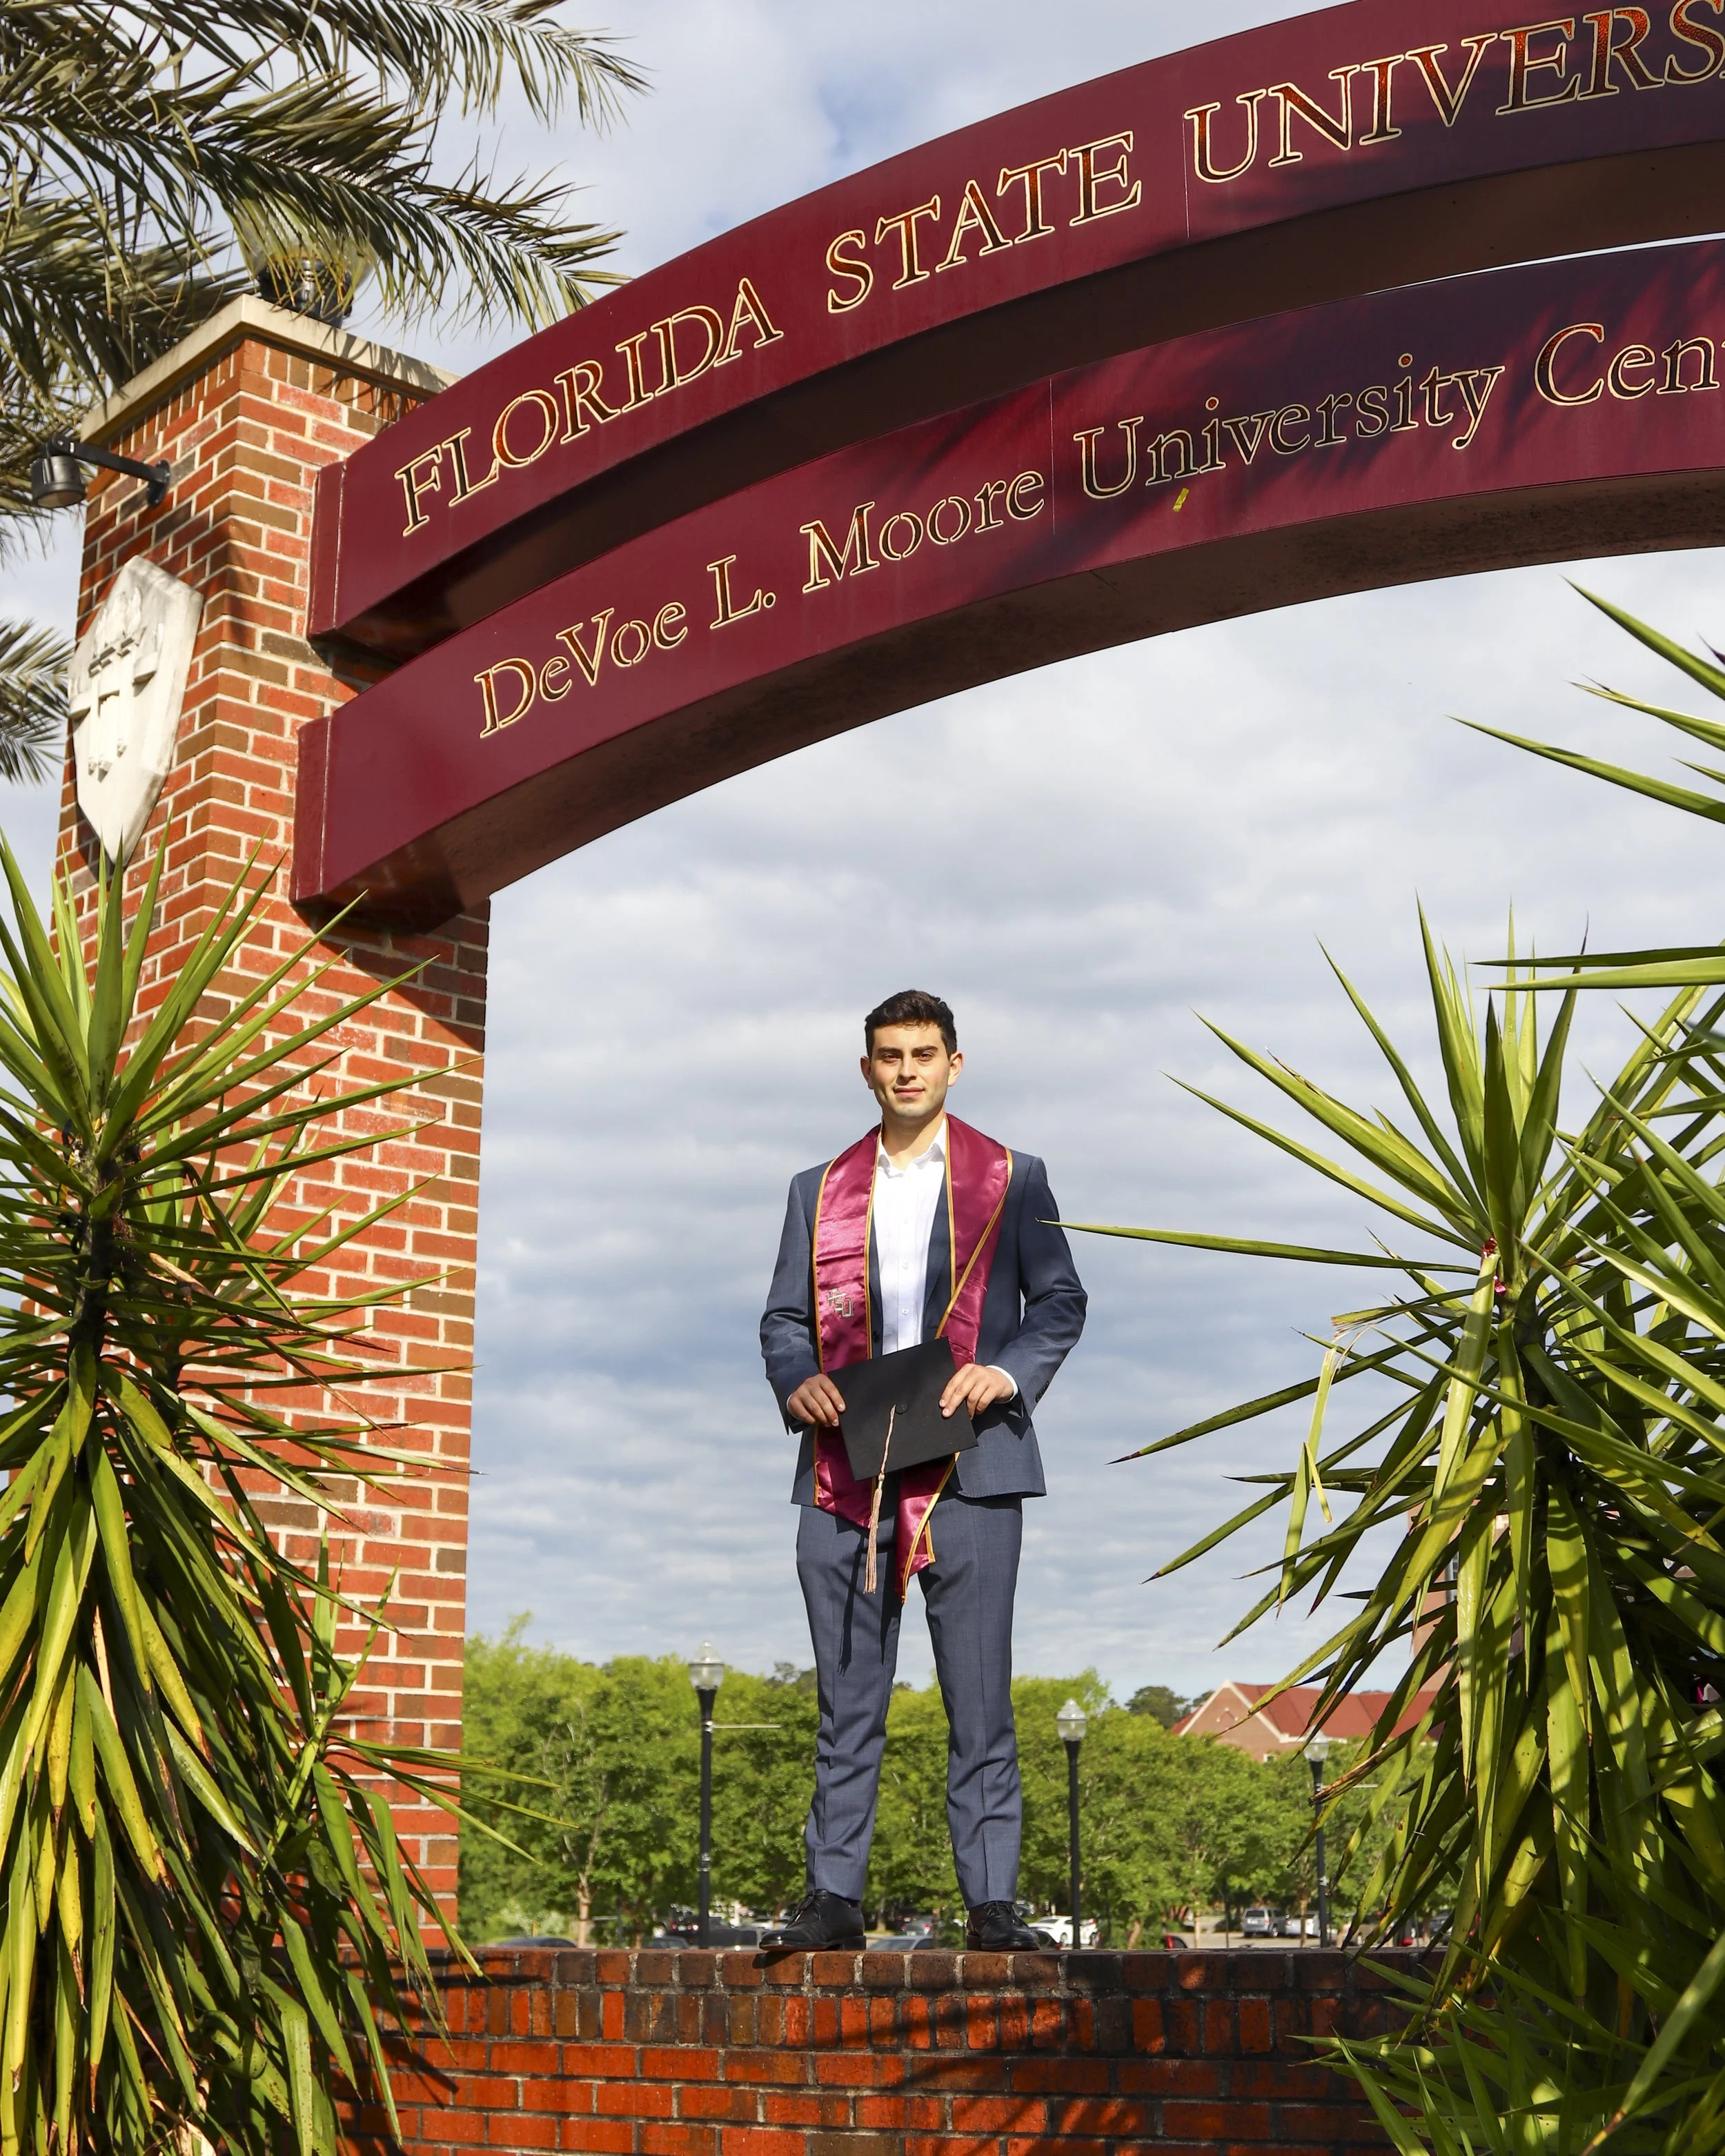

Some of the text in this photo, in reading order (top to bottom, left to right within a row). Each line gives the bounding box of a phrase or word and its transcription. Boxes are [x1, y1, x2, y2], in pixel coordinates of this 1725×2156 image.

[394, 0, 1725, 537] FLORIDA STATE UNIVERS
[473, 322, 1725, 740] DeVoe L. Moore University Cen
